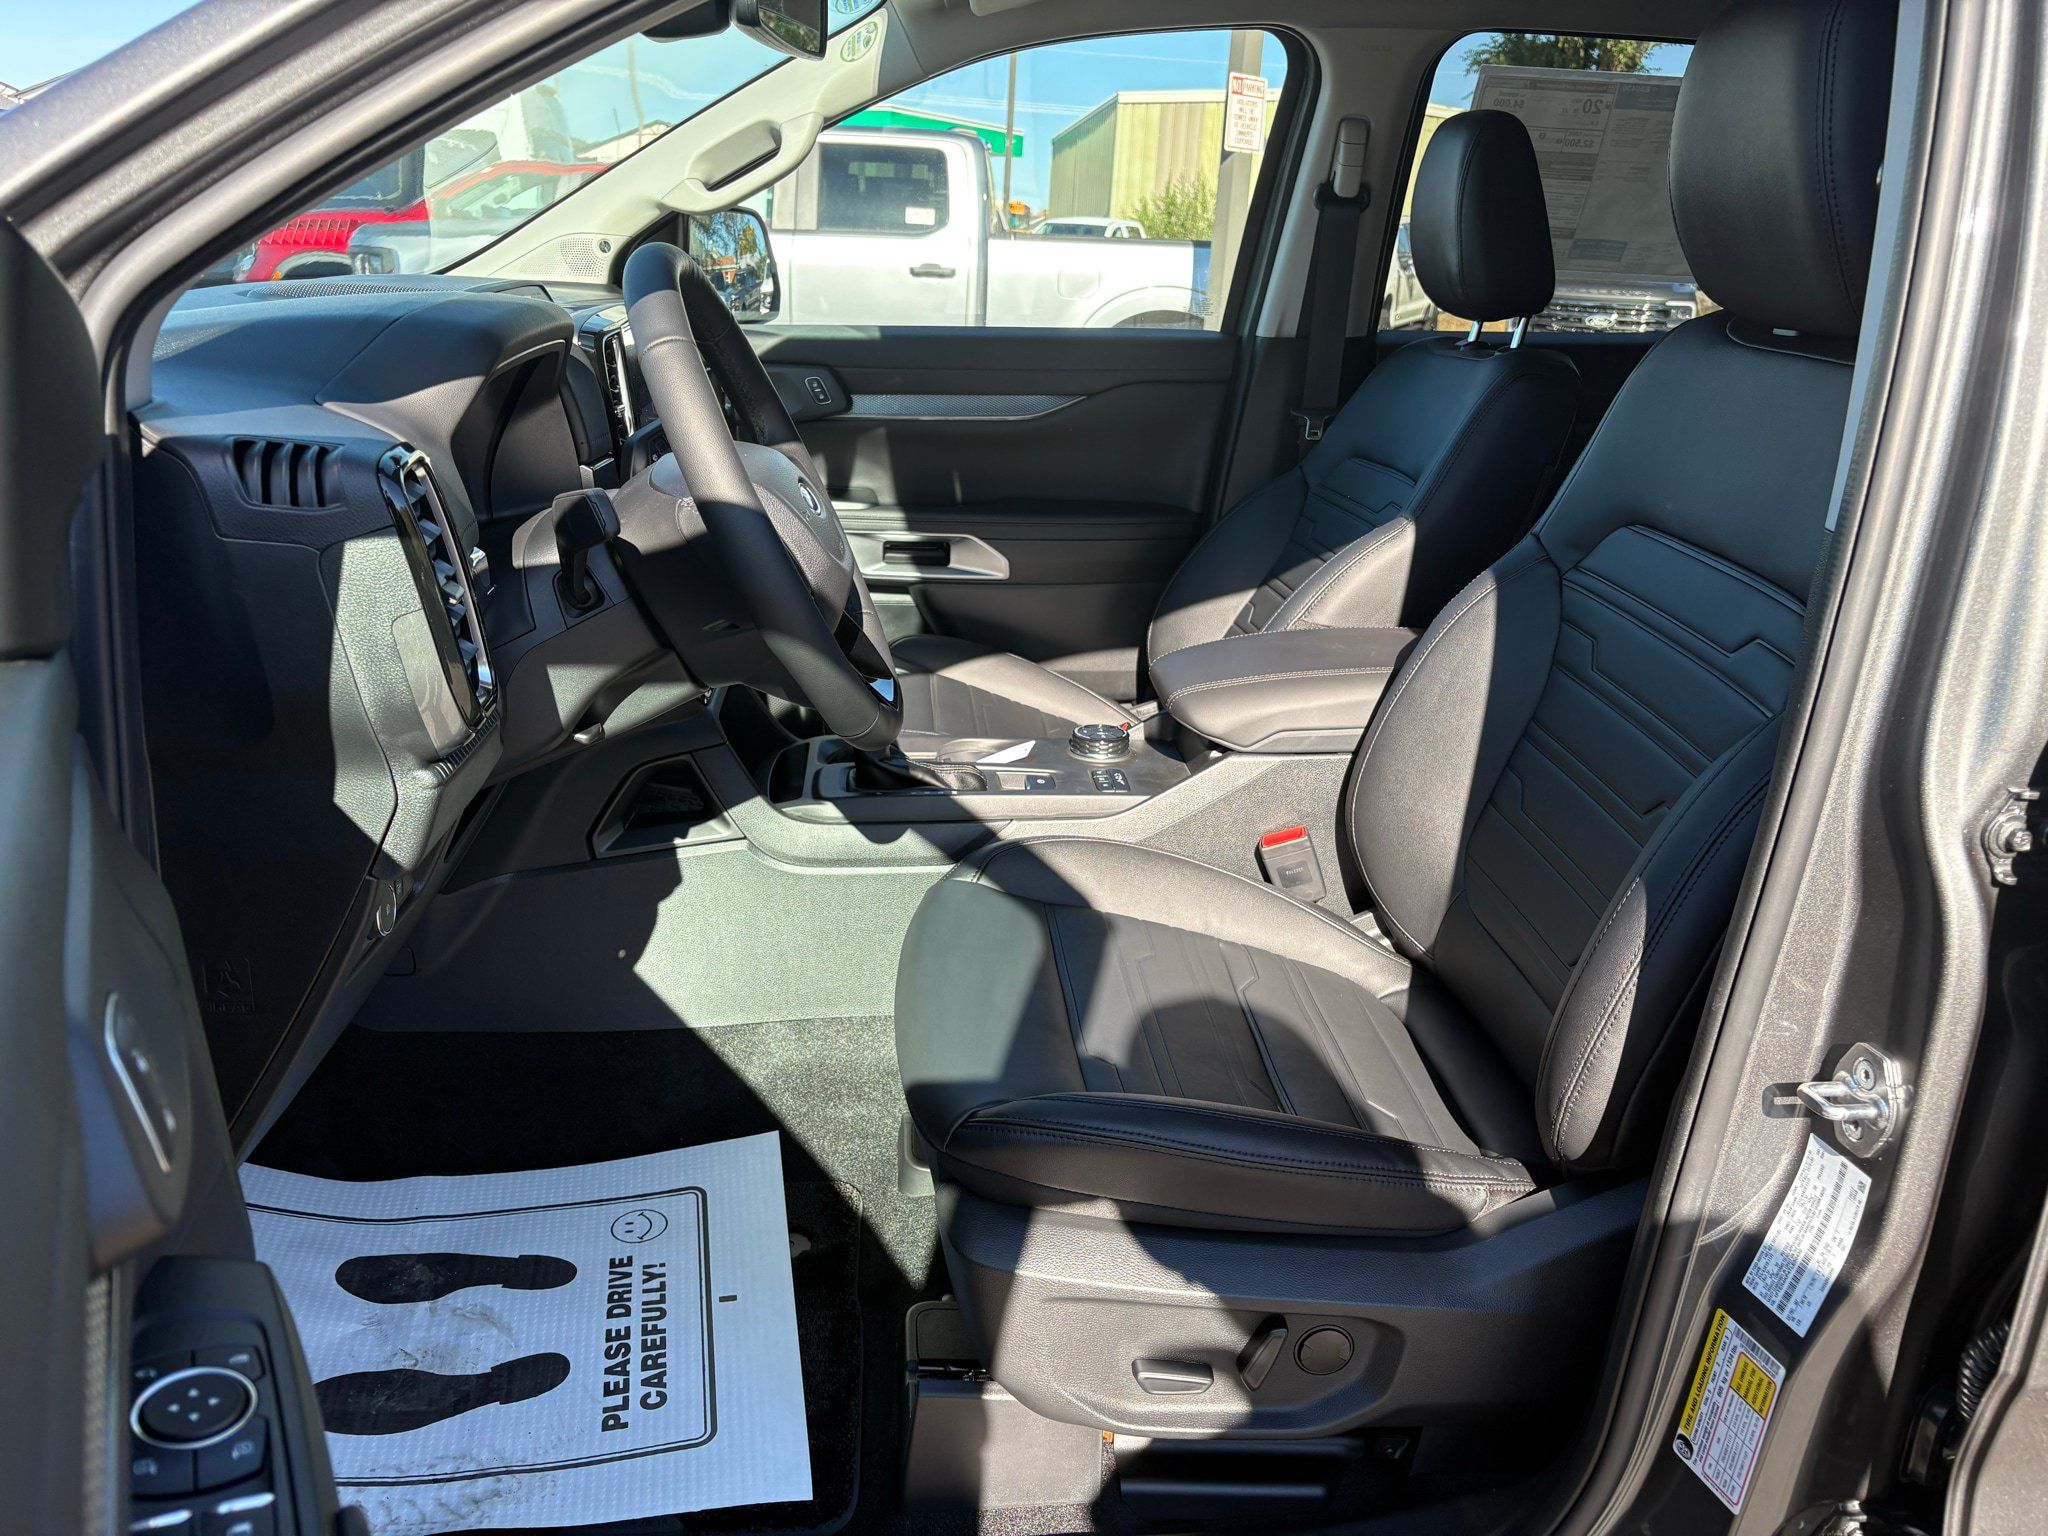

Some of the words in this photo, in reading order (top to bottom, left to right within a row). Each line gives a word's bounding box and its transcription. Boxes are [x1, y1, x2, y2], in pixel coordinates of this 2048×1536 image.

[1232, 79, 1242, 92] NO
[1242, 81, 1264, 94] PARKING
[606, 1255, 632, 1319] DRIVE
[640, 1262, 668, 1410] CAREFULLY!
[602, 1325, 631, 1432] PLEASE
[1684, 1413, 1693, 1432] TIRE
[1689, 1396, 1698, 1414] AND
[1694, 1363, 1709, 1398] LOADING
[1704, 1312, 1726, 1365] INFORMATION
